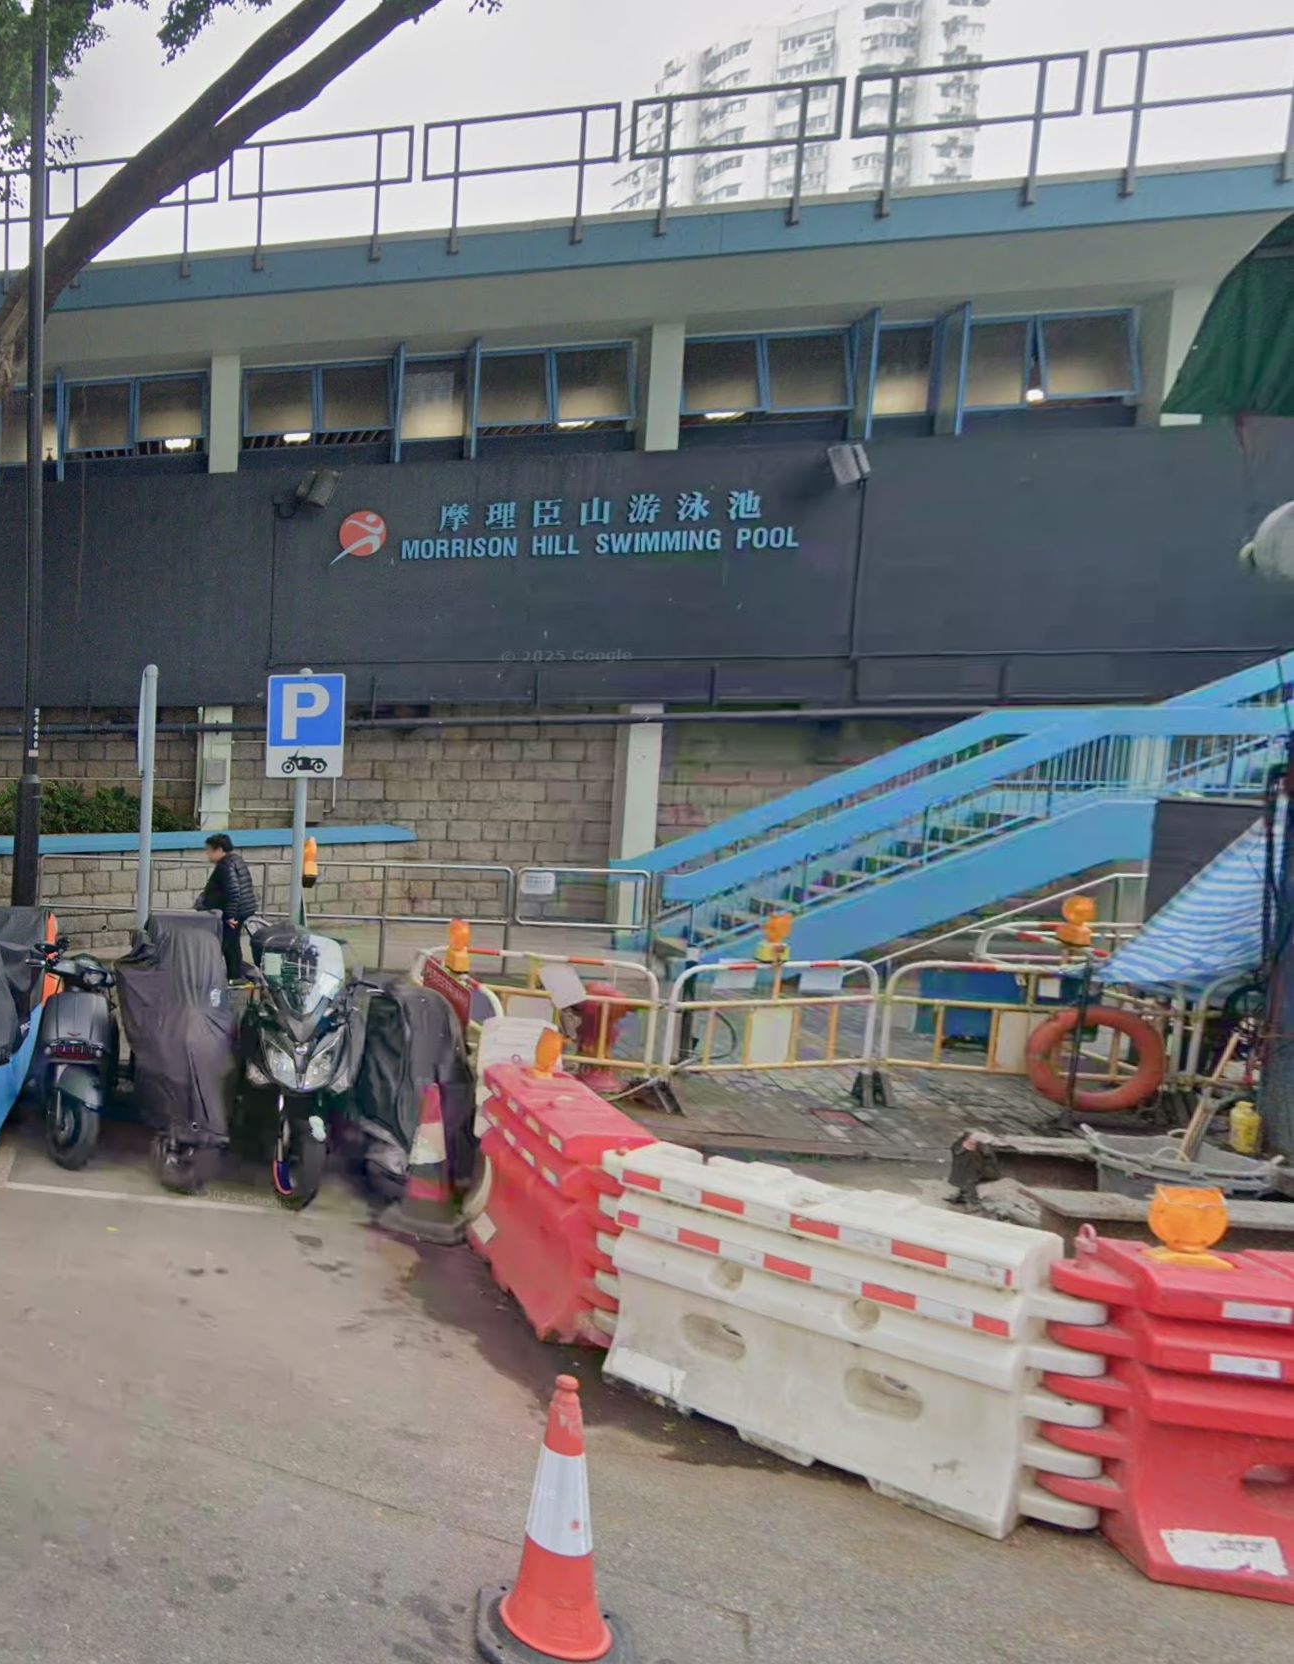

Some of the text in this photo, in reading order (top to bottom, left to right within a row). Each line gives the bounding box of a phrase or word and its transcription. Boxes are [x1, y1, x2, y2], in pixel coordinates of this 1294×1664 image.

[438, 488, 762, 532] 摩理臣山游泳池
[401, 526, 799, 560] MORRISON HILL SWIMMING POOL
[281, 682, 330, 740] P
